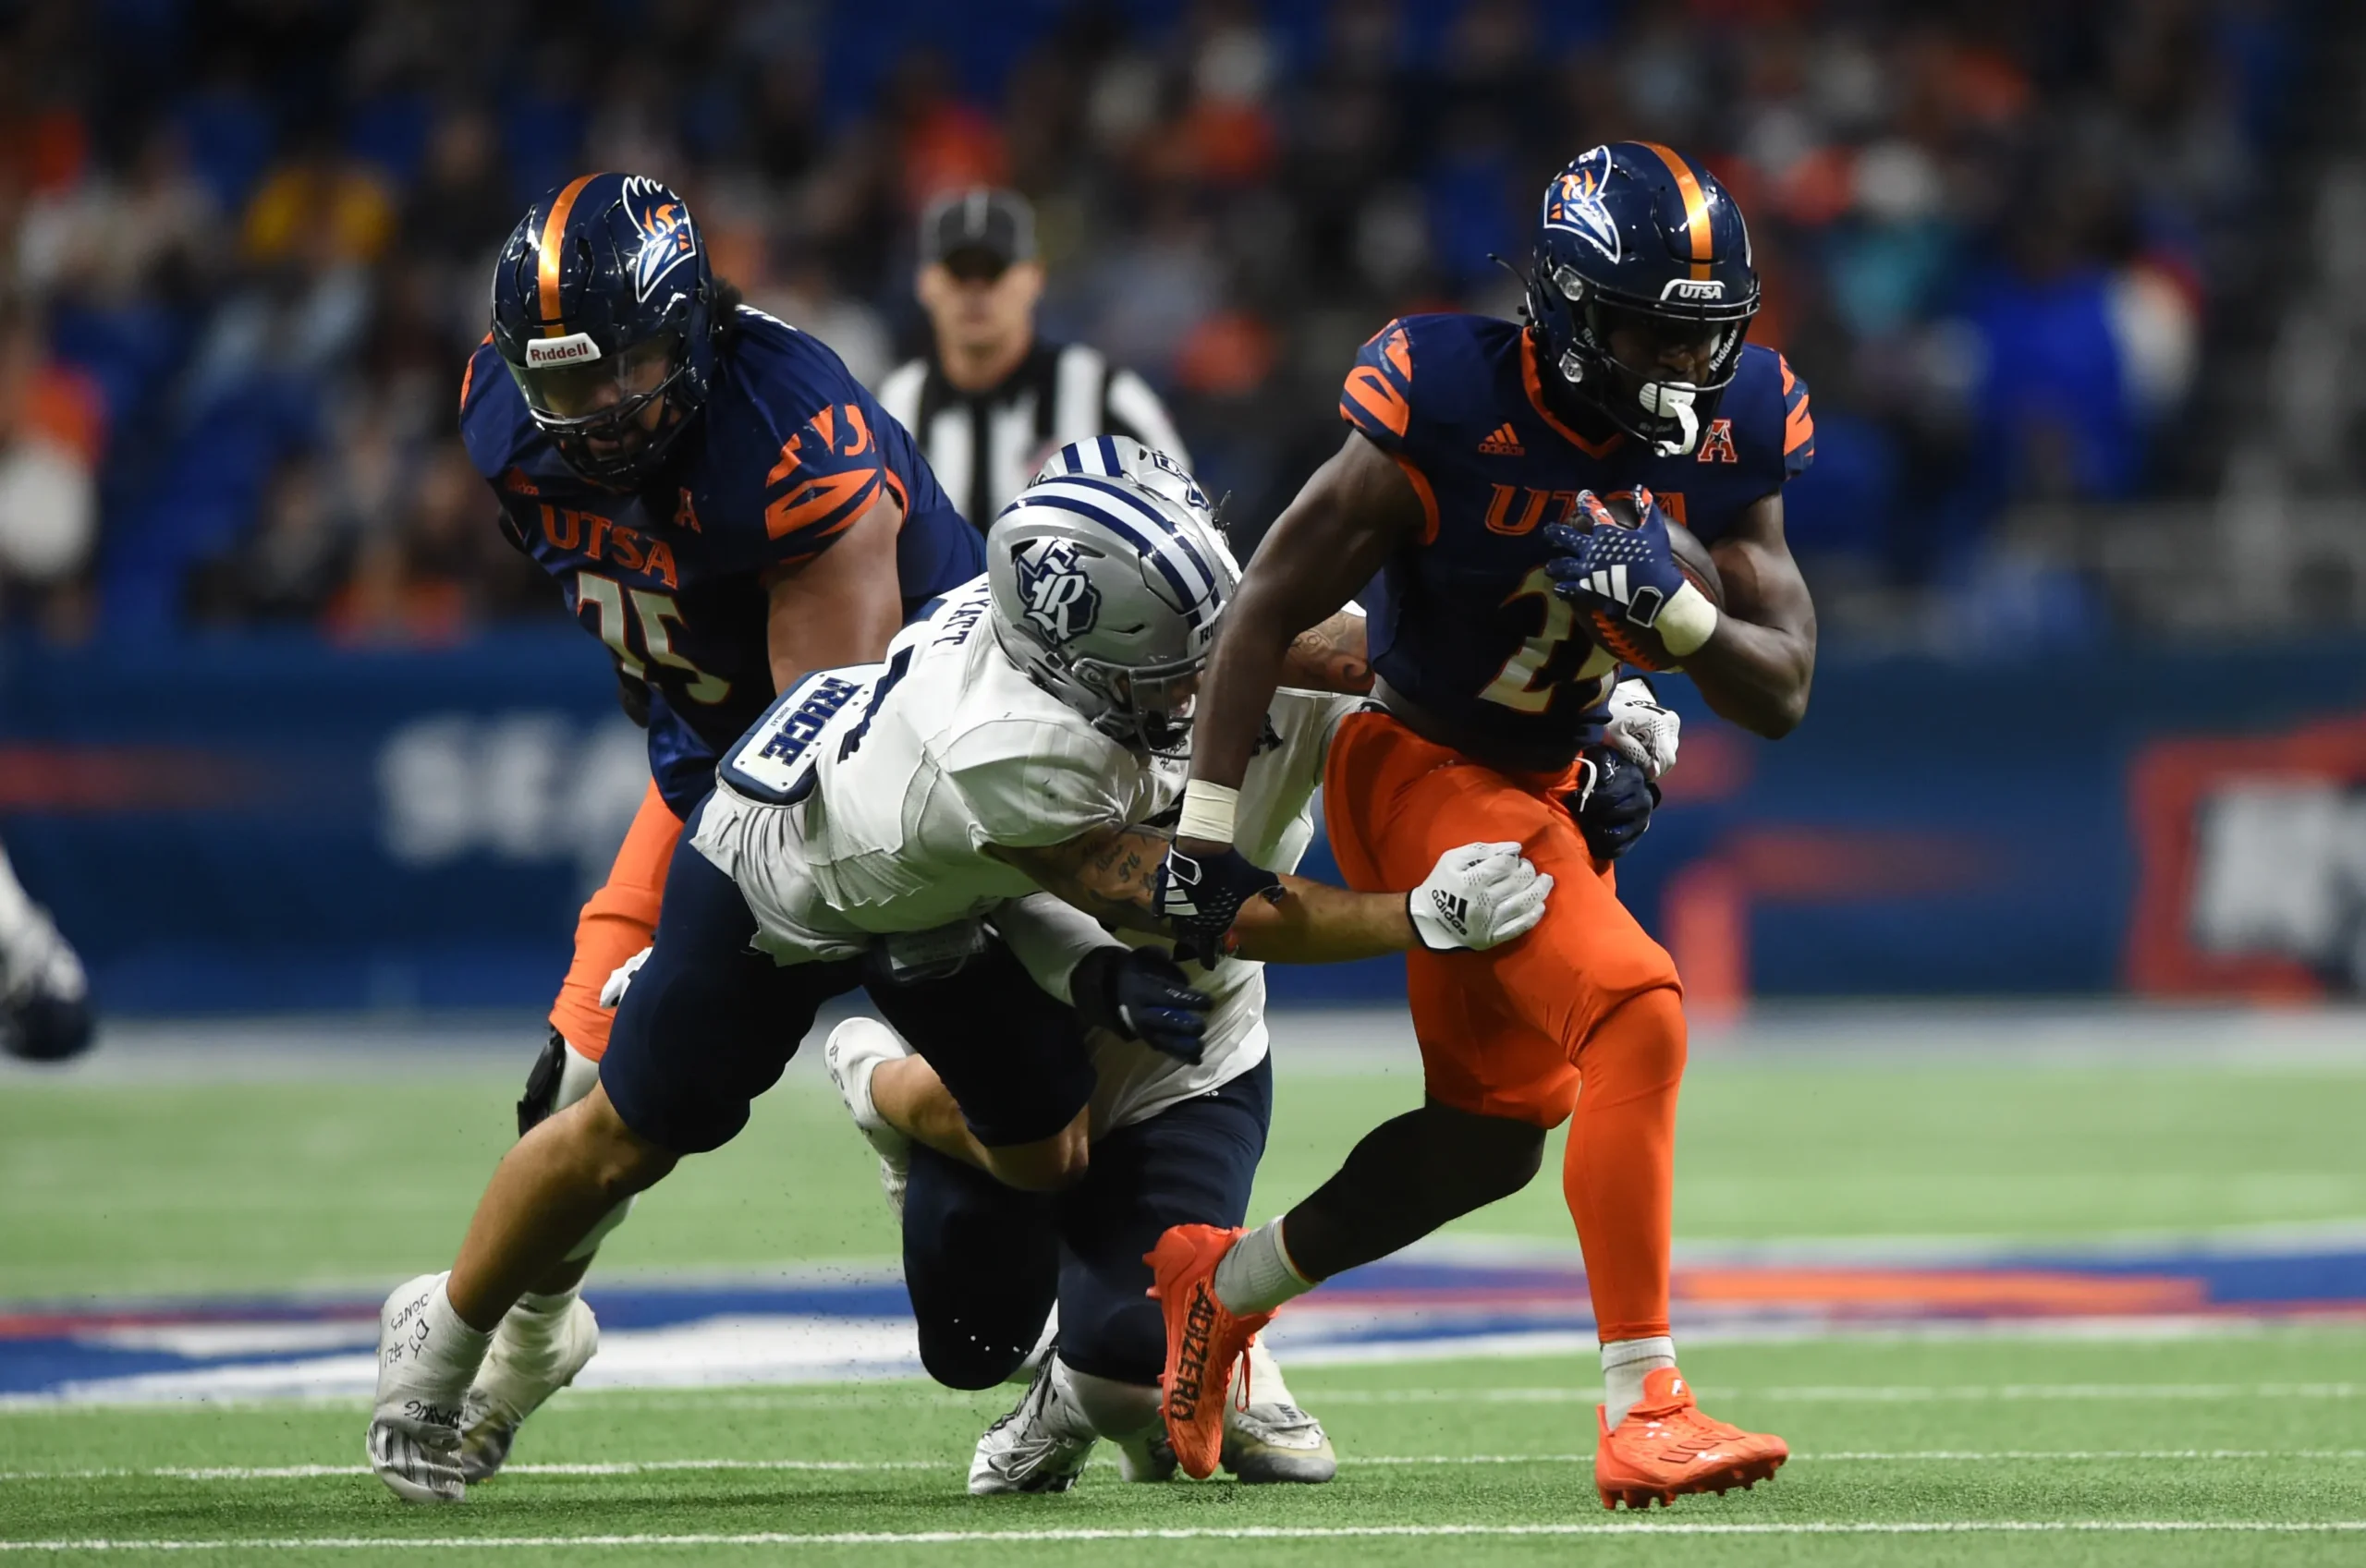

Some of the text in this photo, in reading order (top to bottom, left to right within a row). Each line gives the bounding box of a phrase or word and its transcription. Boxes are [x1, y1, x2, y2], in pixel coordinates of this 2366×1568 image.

[1678, 284, 1722, 299] UTSA
[530, 342, 589, 361] Riddell
[1709, 328, 1738, 371] Riddell
[1484, 482, 1688, 536] UTA
[540, 504, 678, 590] UTSA
[576, 570, 731, 705] 75
[933, 582, 992, 646] YATT
[757, 676, 865, 767] RICE
[1432, 889, 1468, 936] adidas
[1168, 1281, 1217, 1422] ADIZERO
